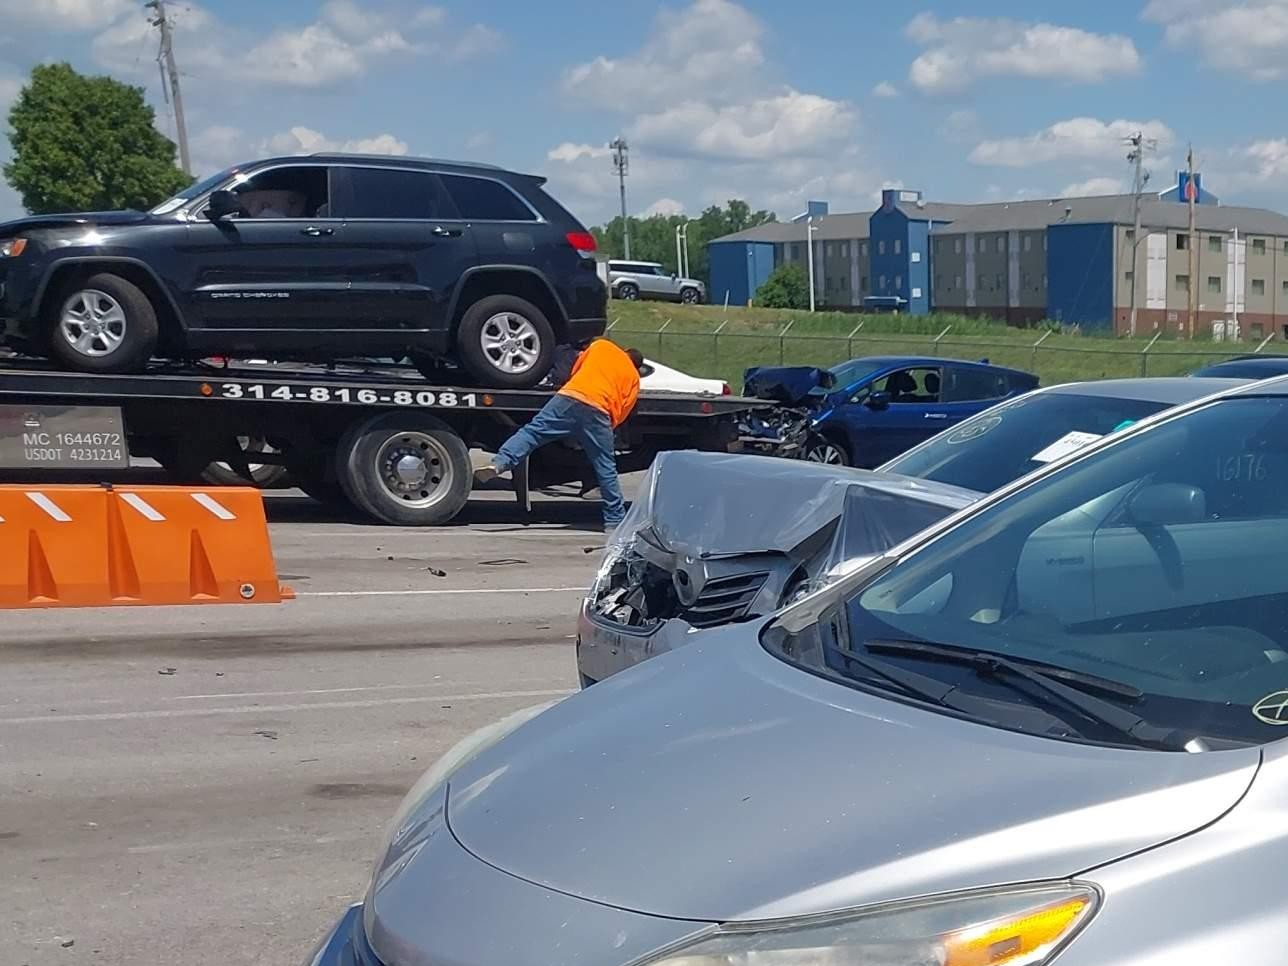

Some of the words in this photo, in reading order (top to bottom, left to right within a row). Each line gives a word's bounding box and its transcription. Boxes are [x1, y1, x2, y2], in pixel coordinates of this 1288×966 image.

[221, 383, 477, 408] 314-816-8081
[23, 433, 50, 446] MC
[56, 433, 121, 446] 1644672
[24, 449, 62, 461] USDOT
[70, 449, 122, 461] 4231214
